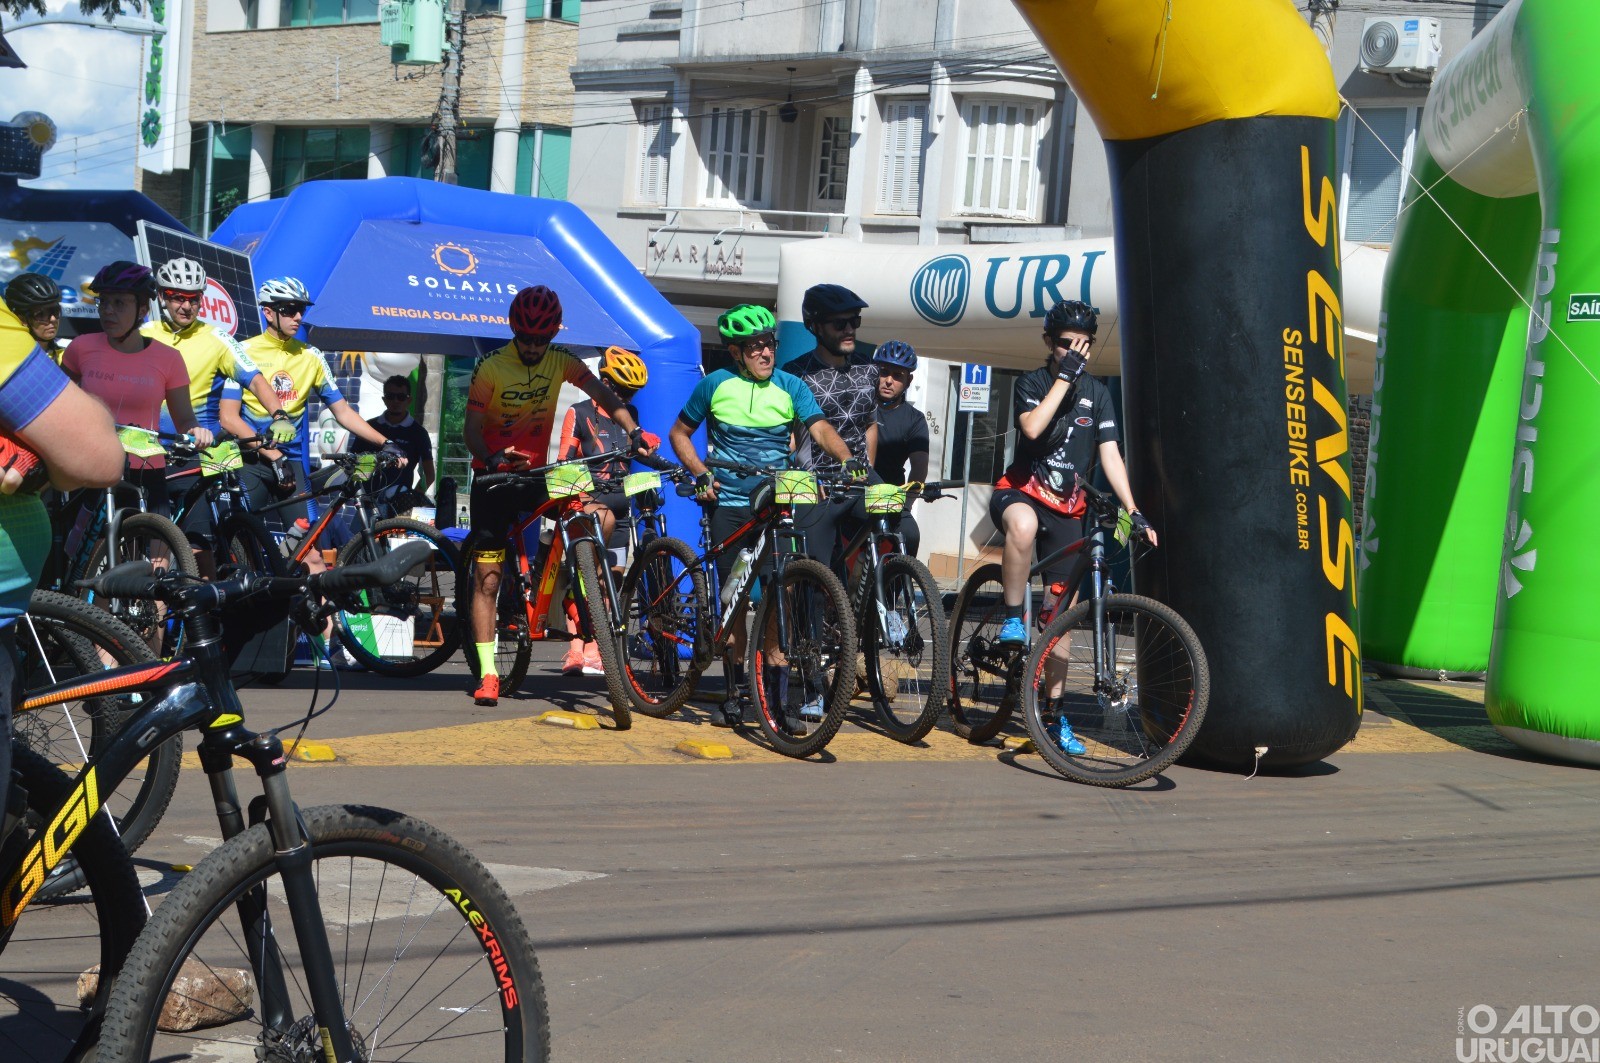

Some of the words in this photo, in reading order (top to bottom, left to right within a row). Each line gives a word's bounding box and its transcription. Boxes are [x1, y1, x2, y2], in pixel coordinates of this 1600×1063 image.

[653, 244, 744, 267] MARIAH
[407, 275, 519, 296] SOLAXIS
[428, 292, 505, 304] ENGENHARIA
[984, 250, 1107, 320] URI
[198, 296, 232, 325] BYD
[371, 306, 431, 320] ENERGIA
[433, 311, 479, 323] SOLAR
[228, 338, 255, 368] Sicredi
[1301, 145, 1362, 716] SENSE
[443, 887, 519, 1011] ALEXRIMS
